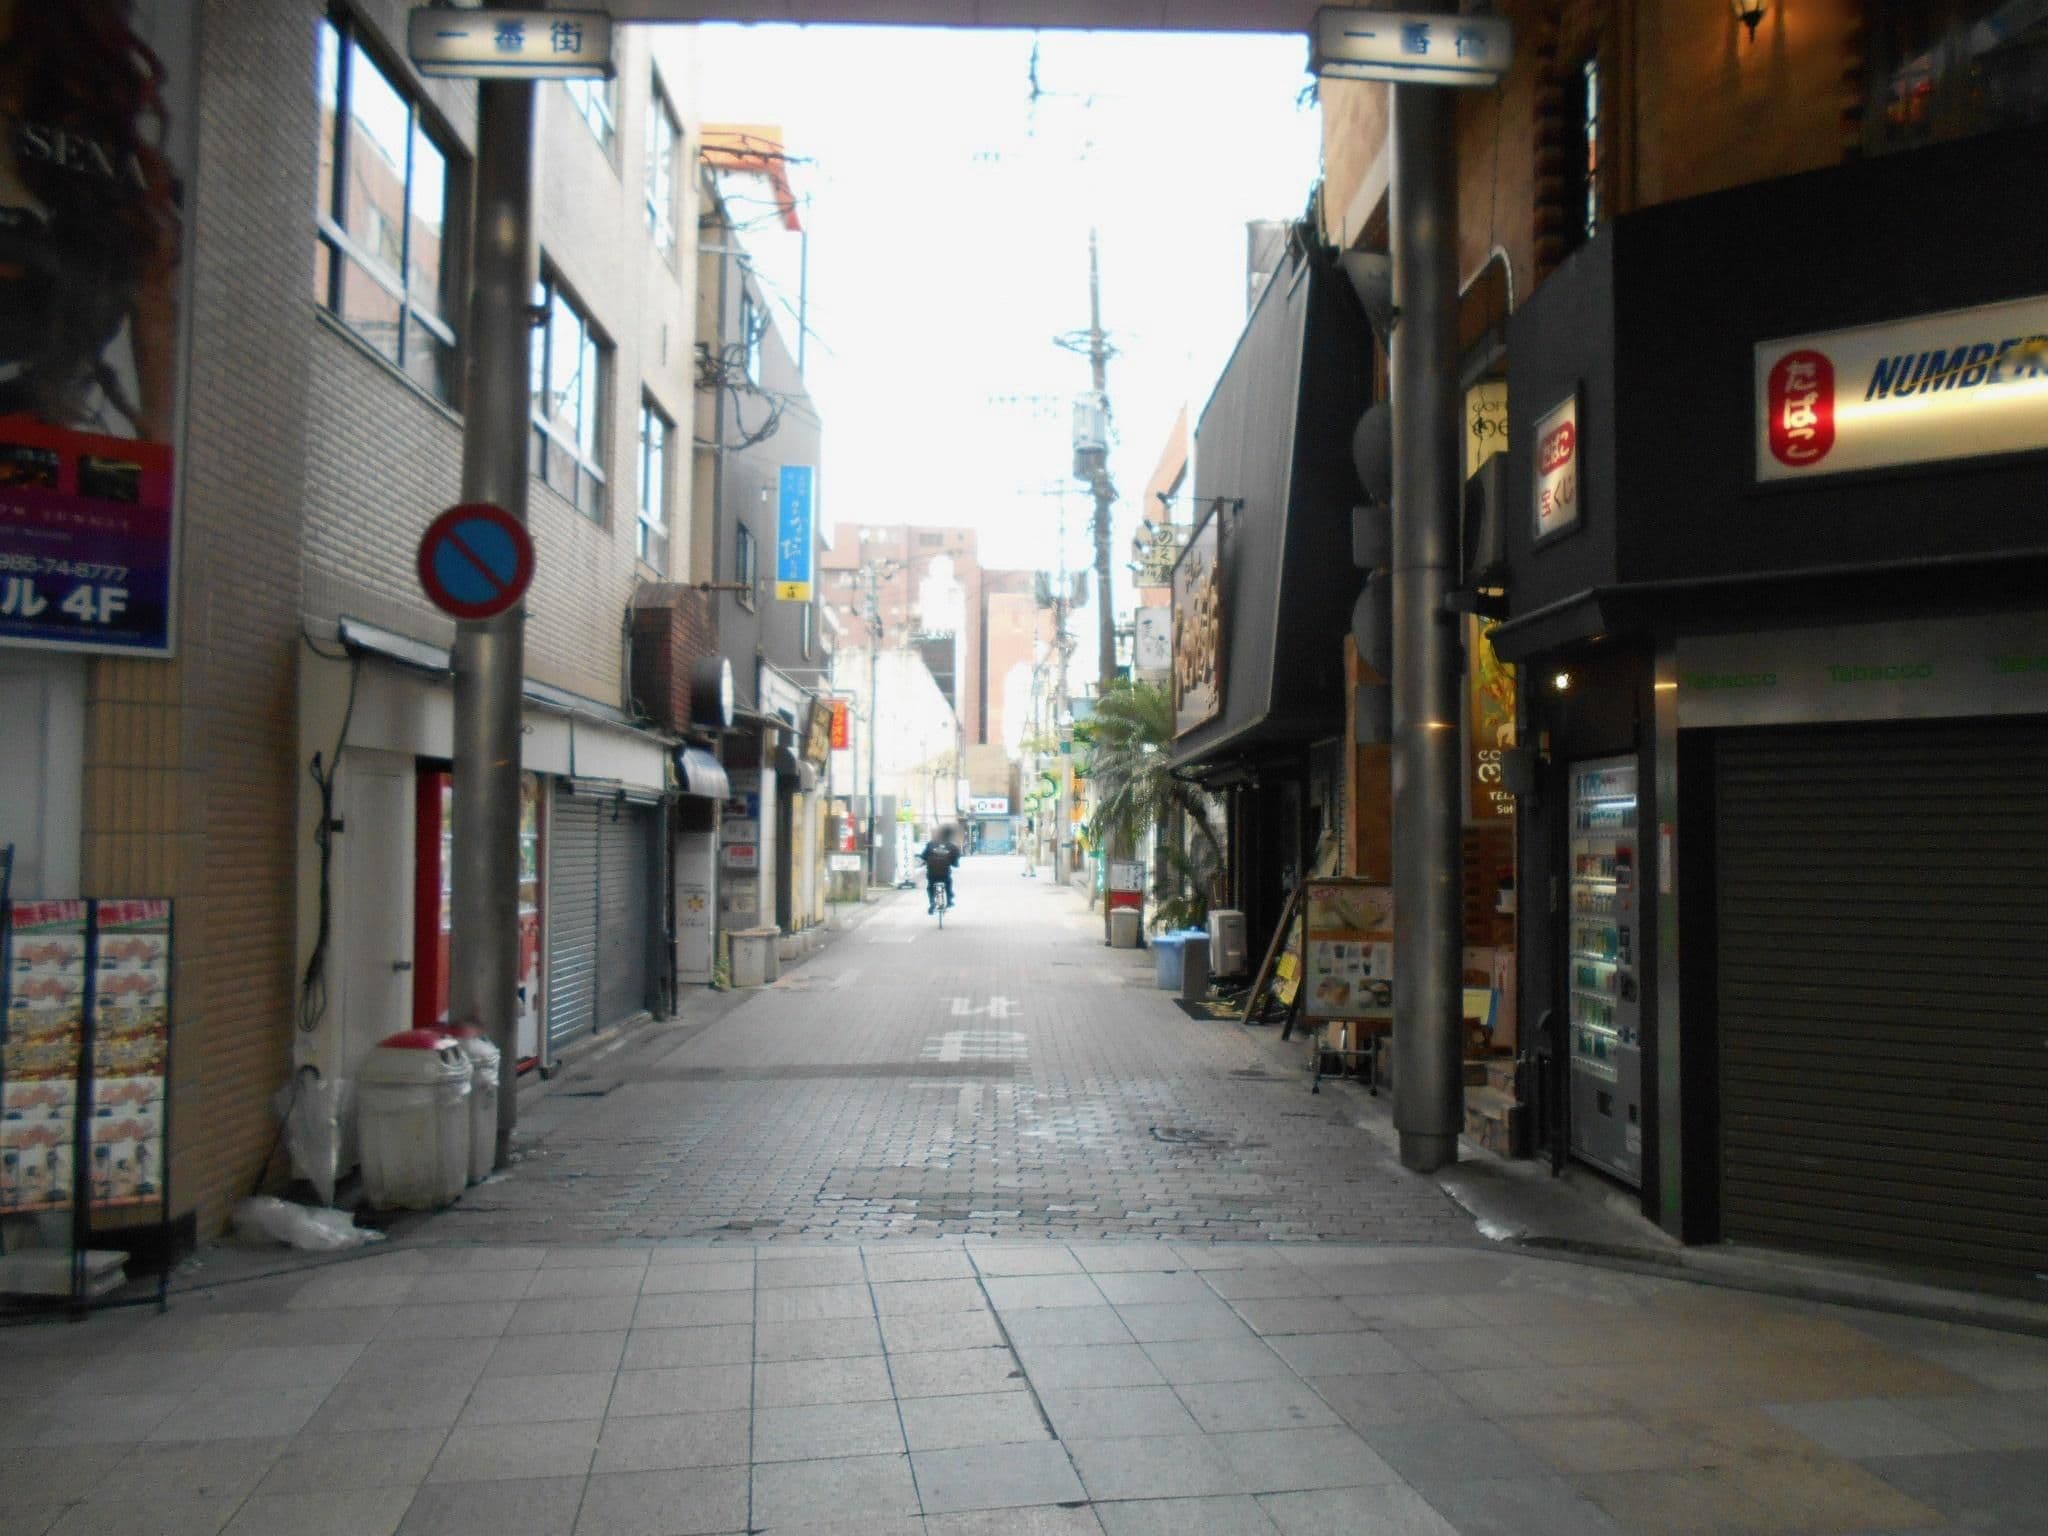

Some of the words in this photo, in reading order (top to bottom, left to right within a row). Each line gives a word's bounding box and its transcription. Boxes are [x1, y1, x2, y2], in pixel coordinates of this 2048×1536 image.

[436, 20, 582, 54] 一番街
[1783, 358, 1820, 459] たばこ
[1, 577, 49, 617] ル
[61, 584, 129, 624] 4F
